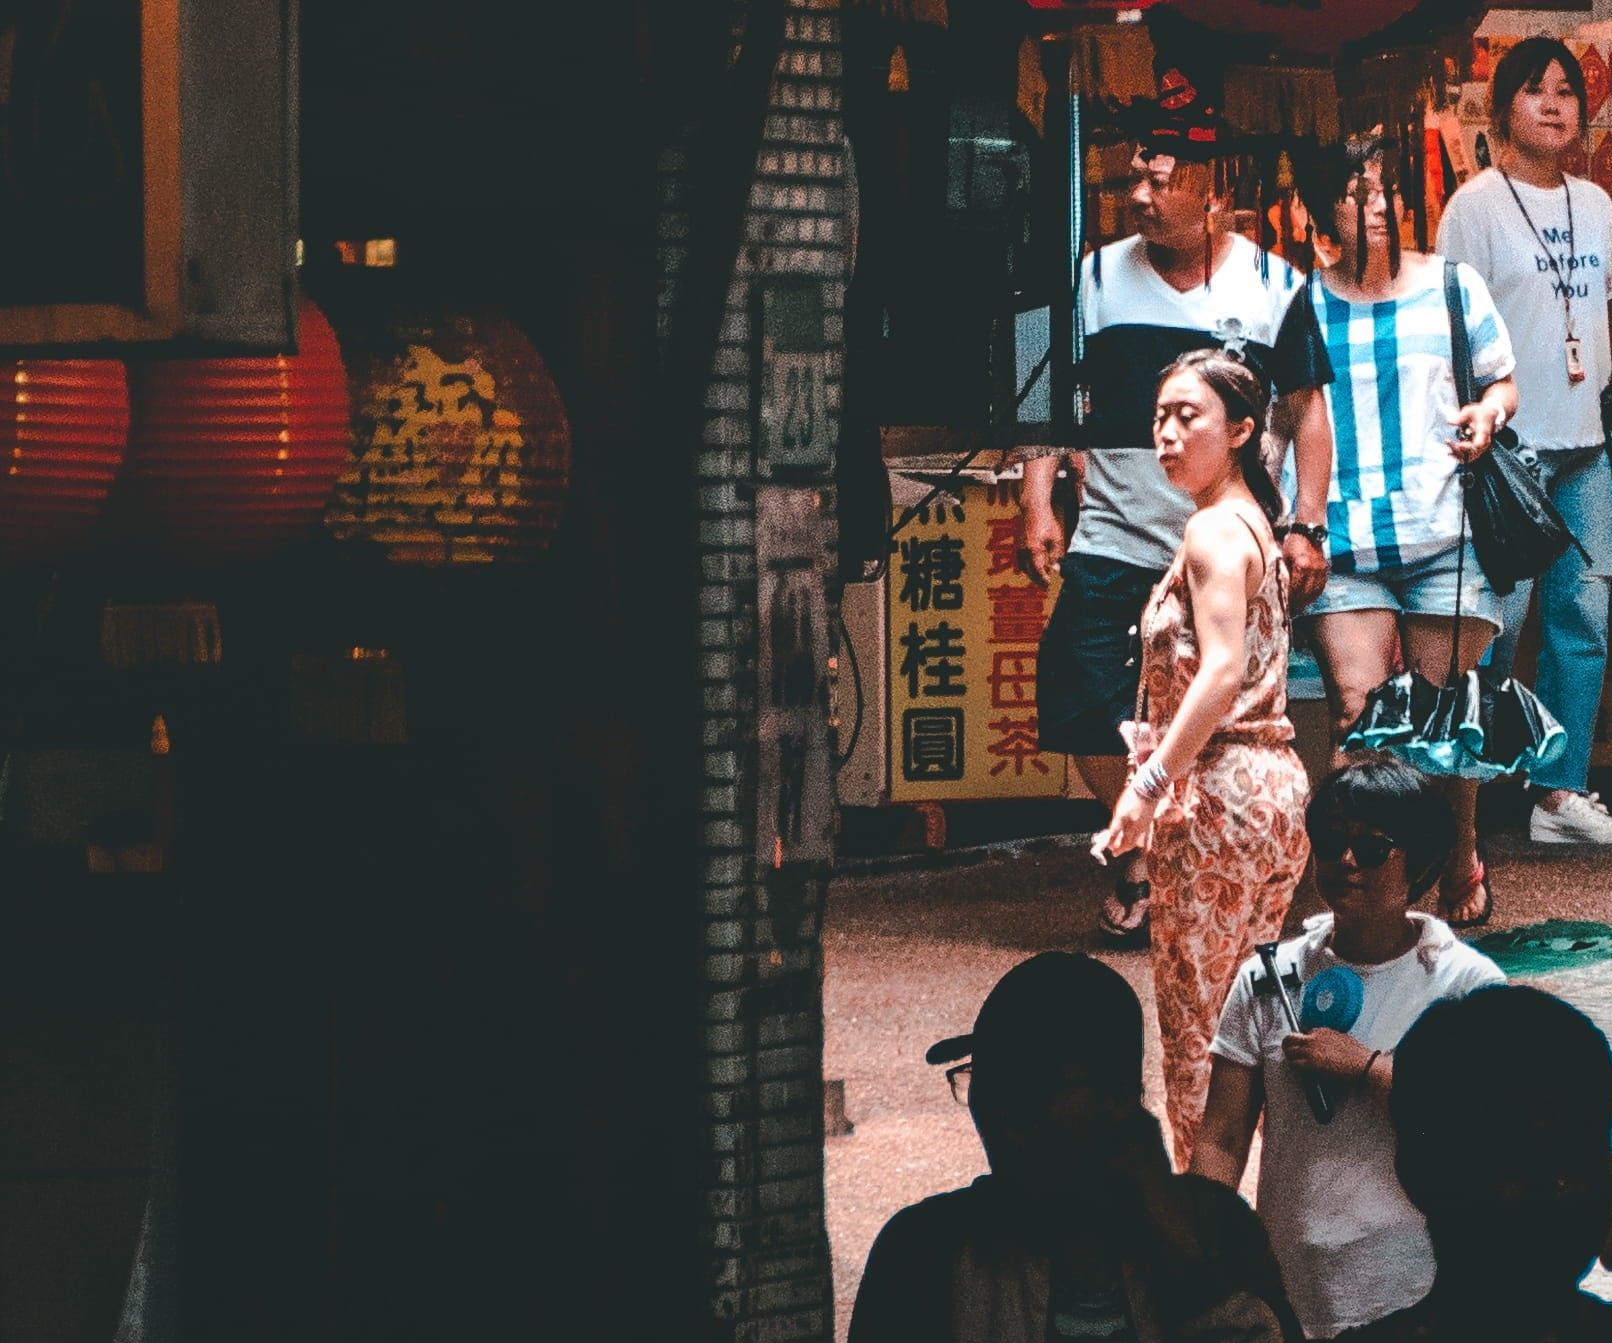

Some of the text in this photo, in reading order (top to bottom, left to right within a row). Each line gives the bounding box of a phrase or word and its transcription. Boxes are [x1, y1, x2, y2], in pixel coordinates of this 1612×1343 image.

[1543, 227, 1573, 245] Me
[1535, 253, 1600, 272] before
[1551, 282, 1589, 300] You
[986, 480, 1049, 777] 棗薑母茶
